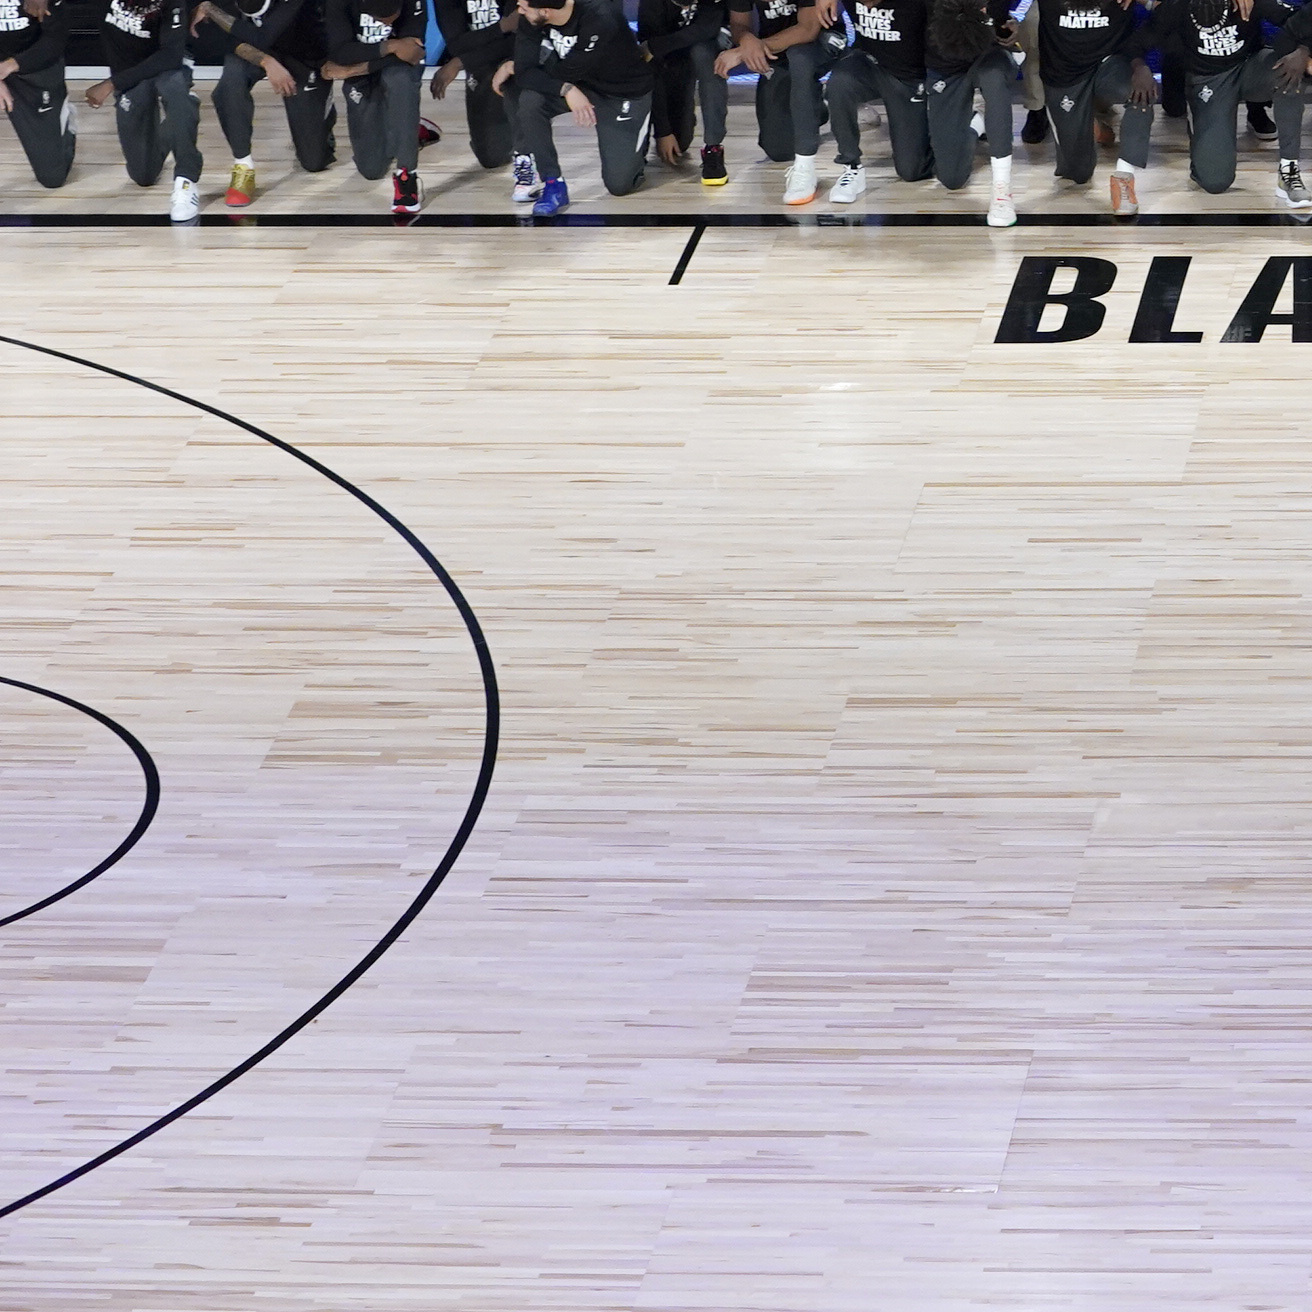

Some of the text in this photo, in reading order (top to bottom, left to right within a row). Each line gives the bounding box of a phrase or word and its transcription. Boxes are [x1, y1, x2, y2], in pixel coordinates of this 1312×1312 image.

[856, 2, 896, 21] BLACK
[860, 15, 891, 31] LIVES
[1059, 15, 1109, 29] MATTER
[854, 22, 901, 41] MATTER
[1204, 36, 1237, 50] LIVES
